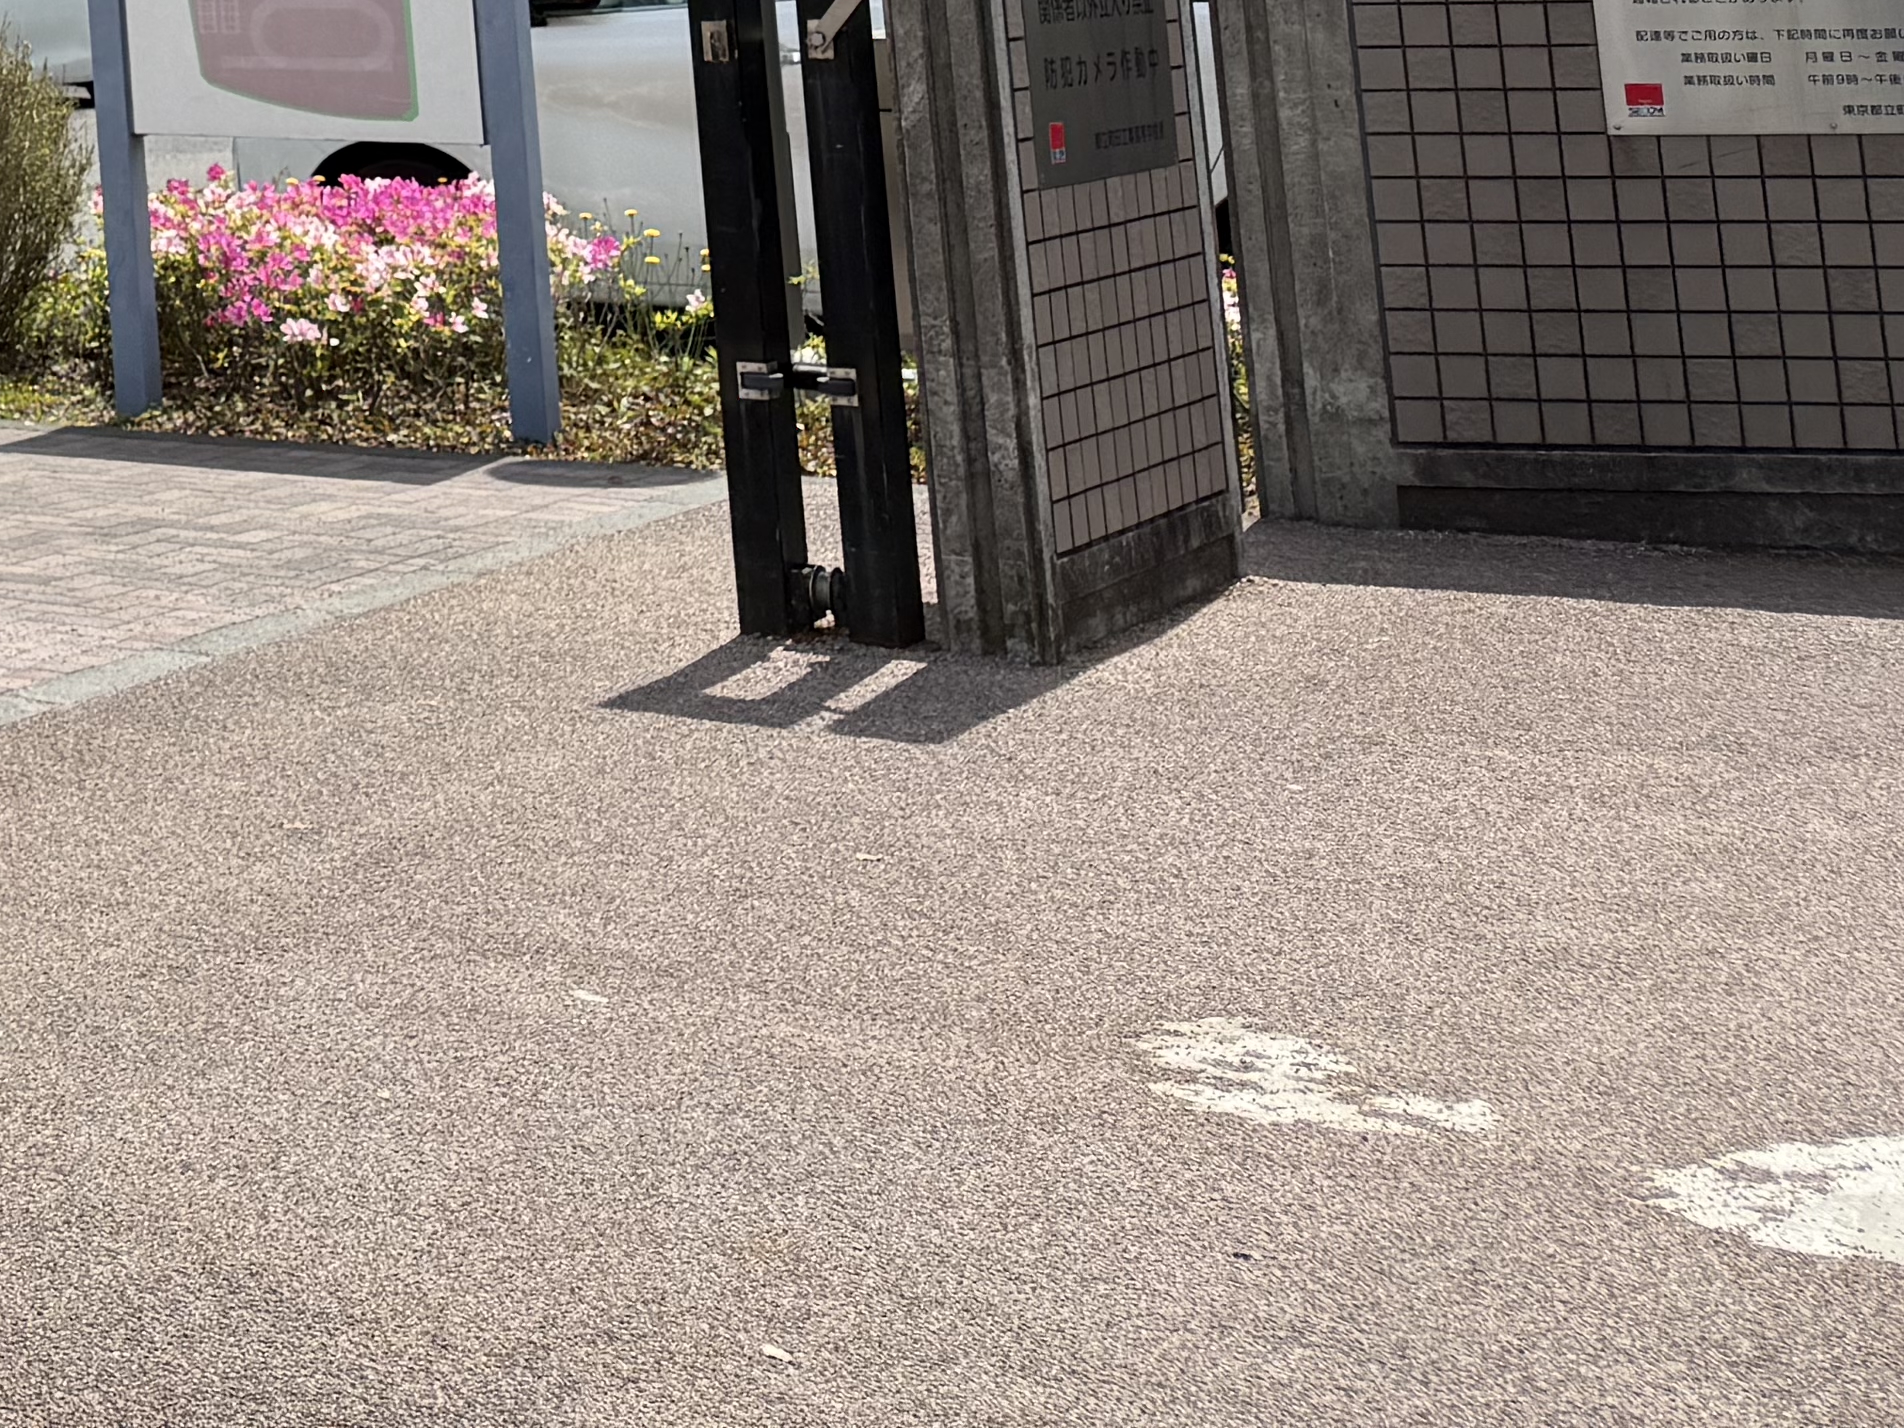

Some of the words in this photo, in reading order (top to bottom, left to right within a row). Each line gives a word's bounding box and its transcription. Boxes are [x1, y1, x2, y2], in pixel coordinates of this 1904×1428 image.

[1044, 48, 1159, 90] 防犯カメラ作動中
